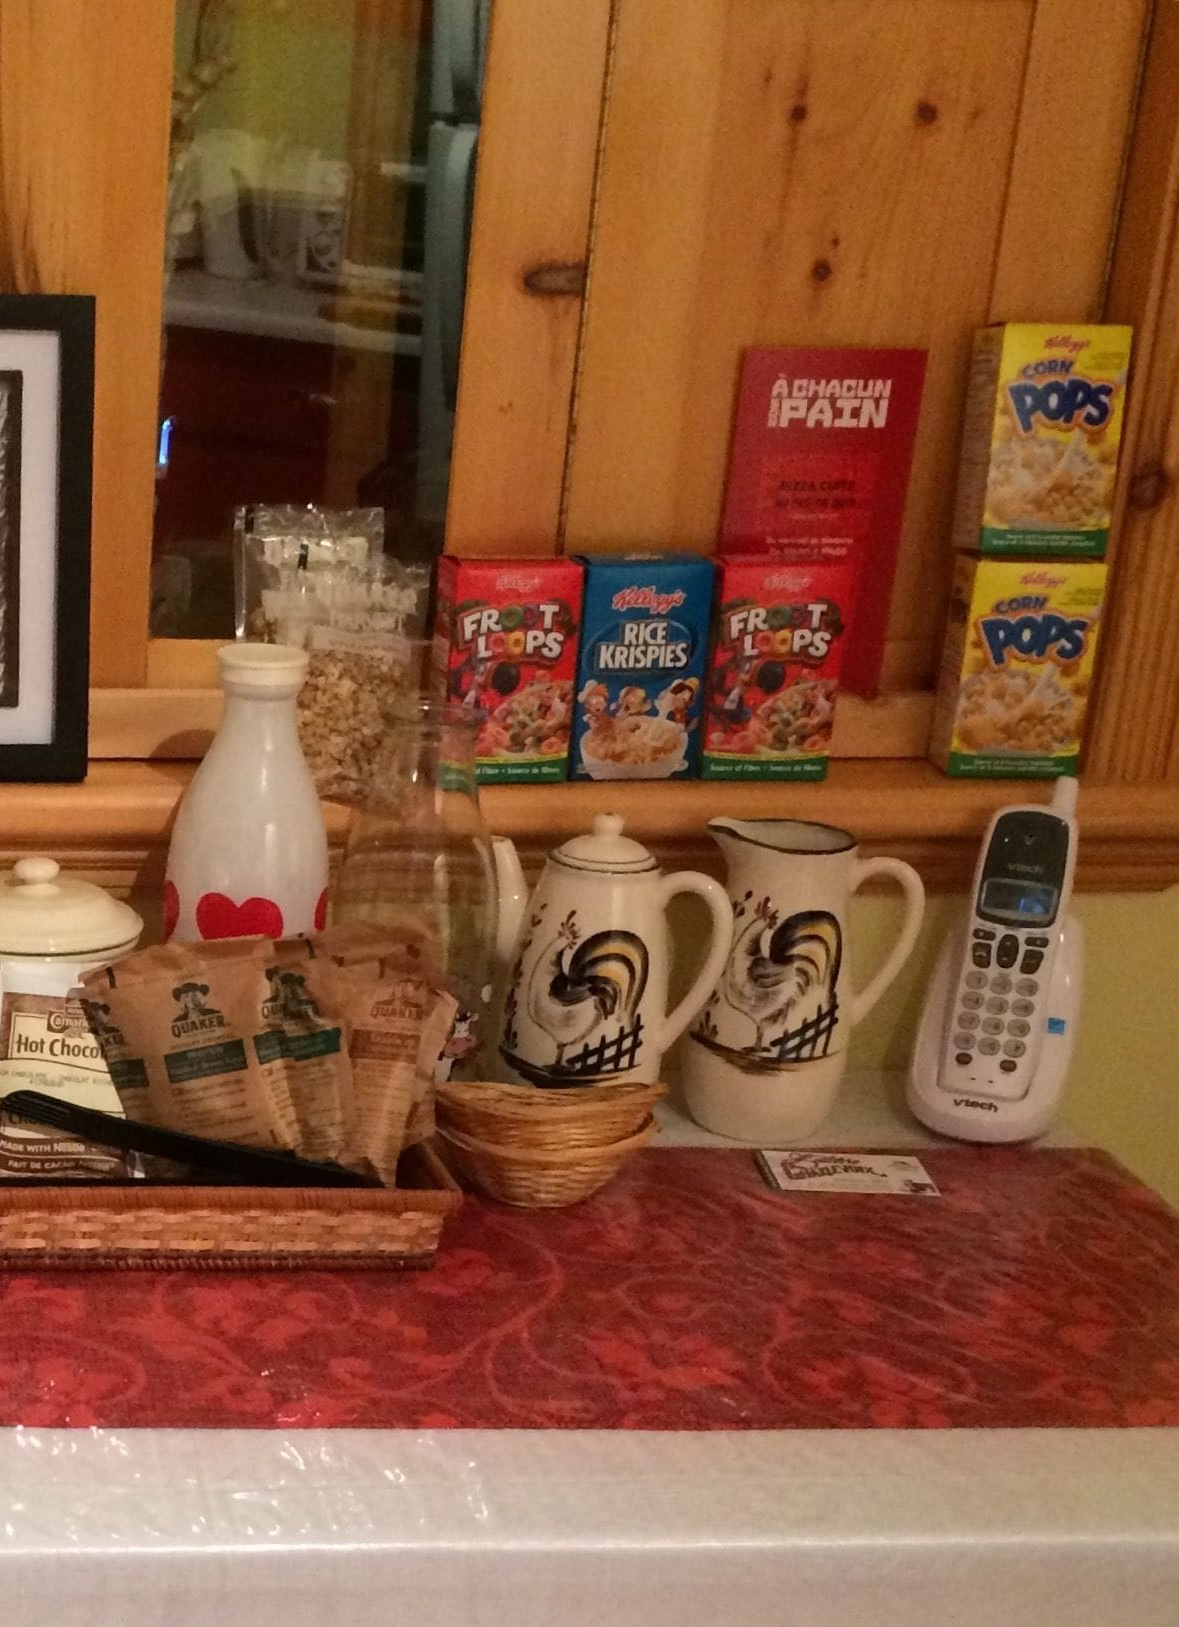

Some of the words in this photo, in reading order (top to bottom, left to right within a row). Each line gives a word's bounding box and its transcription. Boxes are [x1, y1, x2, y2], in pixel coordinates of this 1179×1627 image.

[1022, 359, 1074, 377] CORN
[772, 373, 789, 397] À
[792, 379, 893, 398] CHACUN
[779, 398, 889, 428] PAIN
[1009, 378, 1113, 432] POPS
[612, 586, 686, 614] Kellogg's
[995, 595, 1047, 614] CORN
[463, 604, 560, 641] FROOT
[624, 622, 668, 646] RICE
[730, 604, 828, 639] FROOT
[477, 629, 564, 658] LOOPS
[743, 628, 832, 657] LOOPS
[981, 614, 1089, 664] POPS
[599, 643, 688, 669] KRISPIES
[172, 1014, 226, 1038] QUAKER
[16, 1034, 45, 1054] Hot
[953, 1099, 998, 1113] vtech
[0, 1140, 24, 1152] MADE
[26, 1144, 51, 1153] WITH
